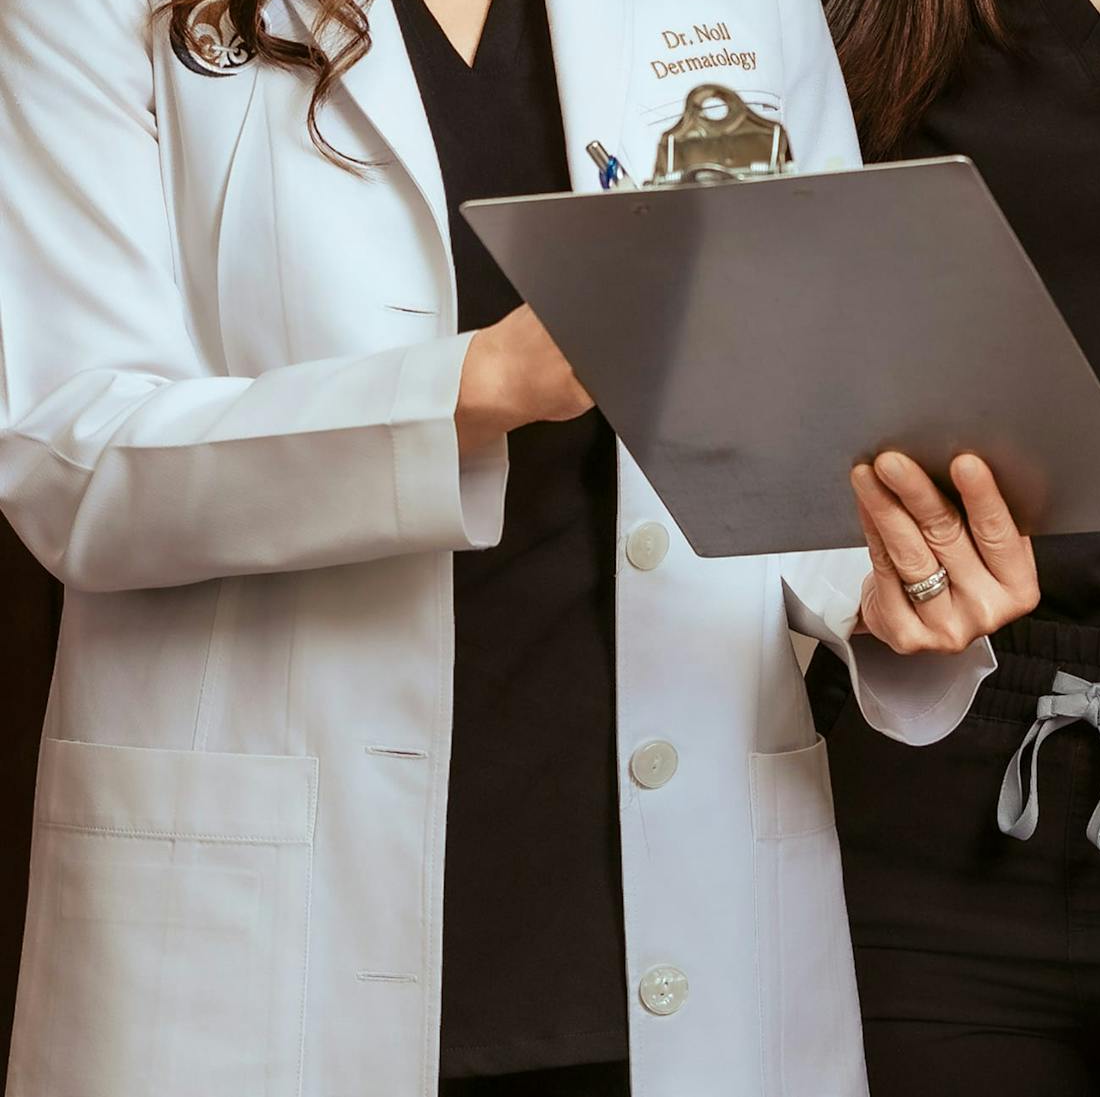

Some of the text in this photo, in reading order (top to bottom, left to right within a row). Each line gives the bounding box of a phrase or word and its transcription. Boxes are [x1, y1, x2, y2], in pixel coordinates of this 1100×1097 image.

[661, 22, 731, 49] Dr. Noll
[650, 47, 756, 79] Dermatology
